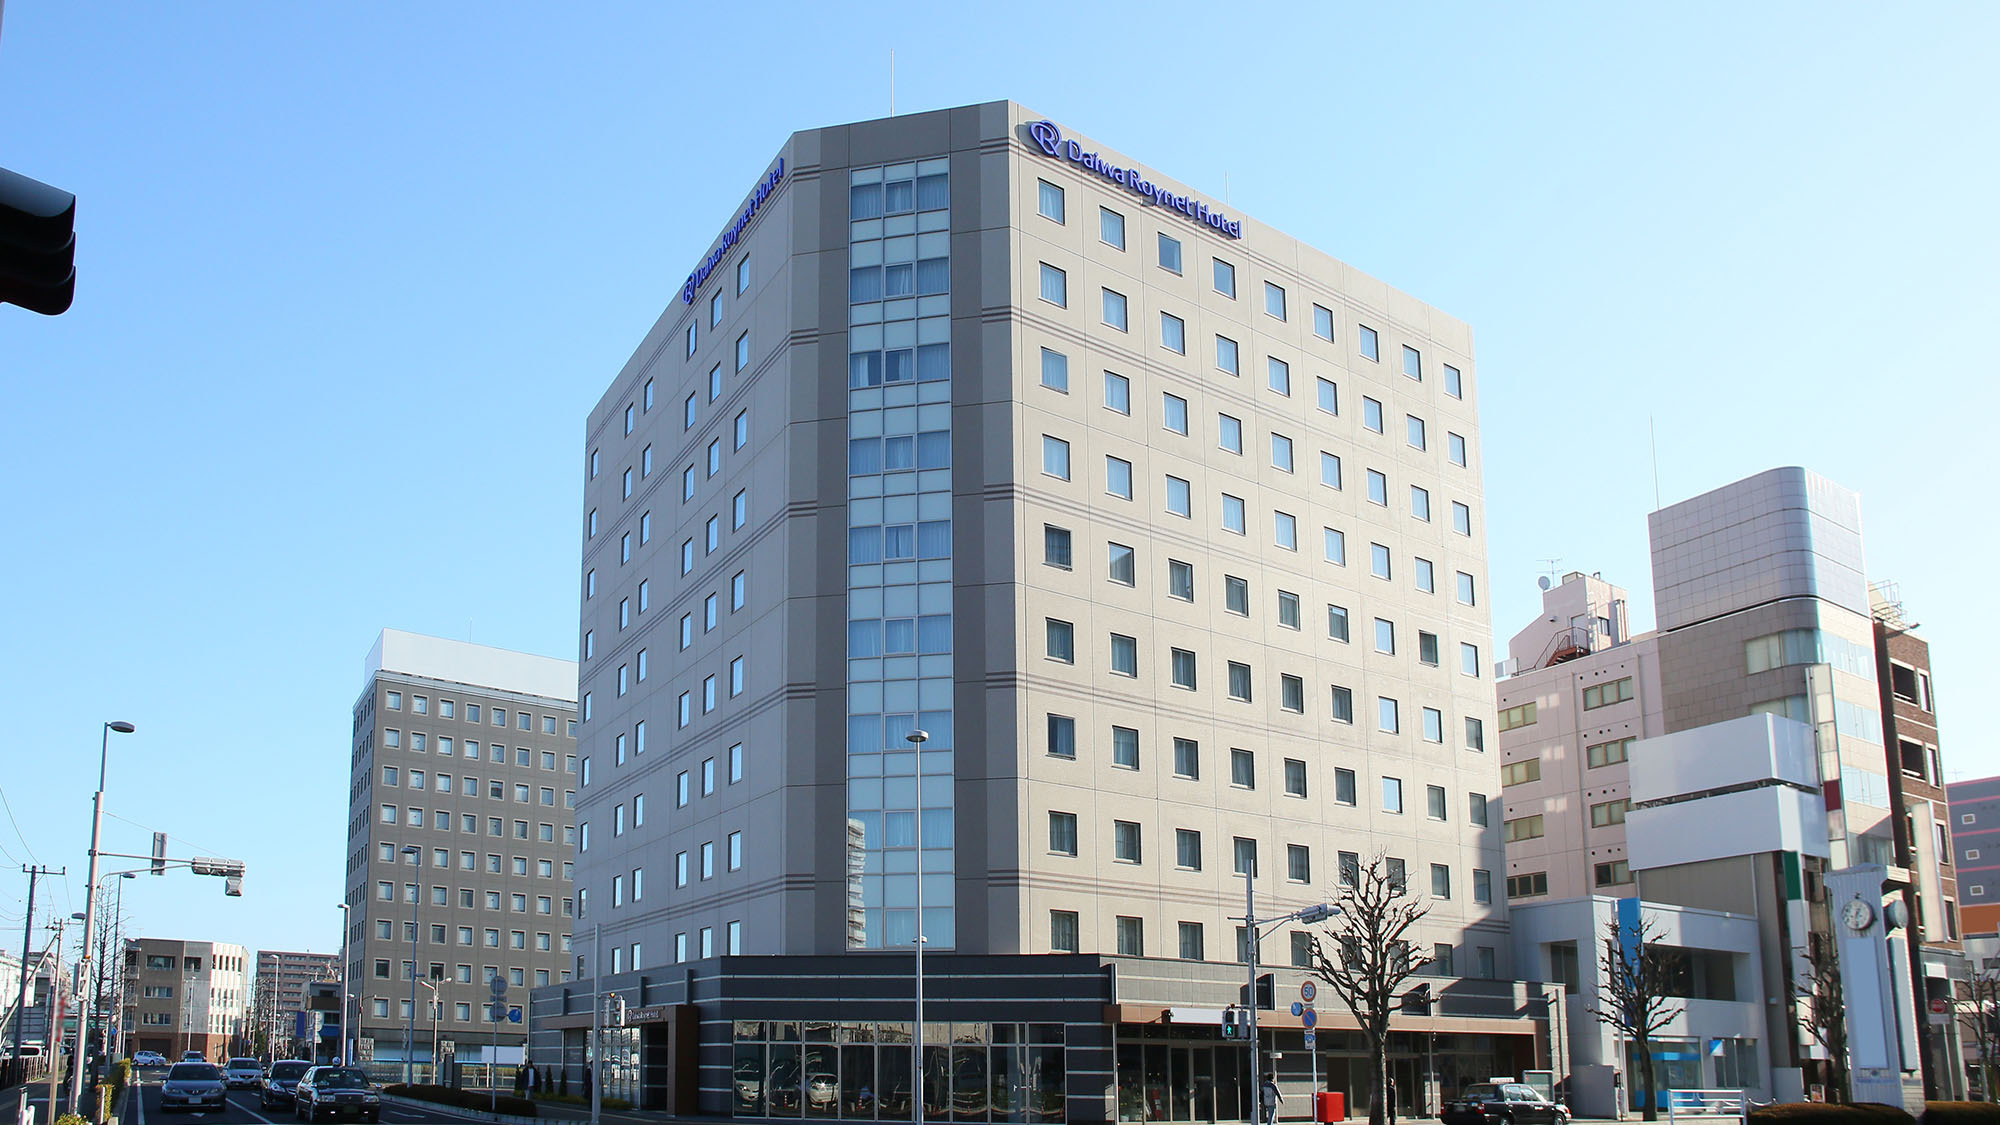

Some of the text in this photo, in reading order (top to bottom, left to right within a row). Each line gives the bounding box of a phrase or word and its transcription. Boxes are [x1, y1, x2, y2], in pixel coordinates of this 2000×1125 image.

[696, 247, 723, 288] Daiwa
[722, 198, 756, 255] Roynet
[755, 158, 784, 210] Hotel
[1068, 139, 1125, 184] Daiwa
[1129, 168, 1194, 217] Roynet
[1195, 200, 1243, 240] Hotel
[1304, 987, 1314, 997] 50
